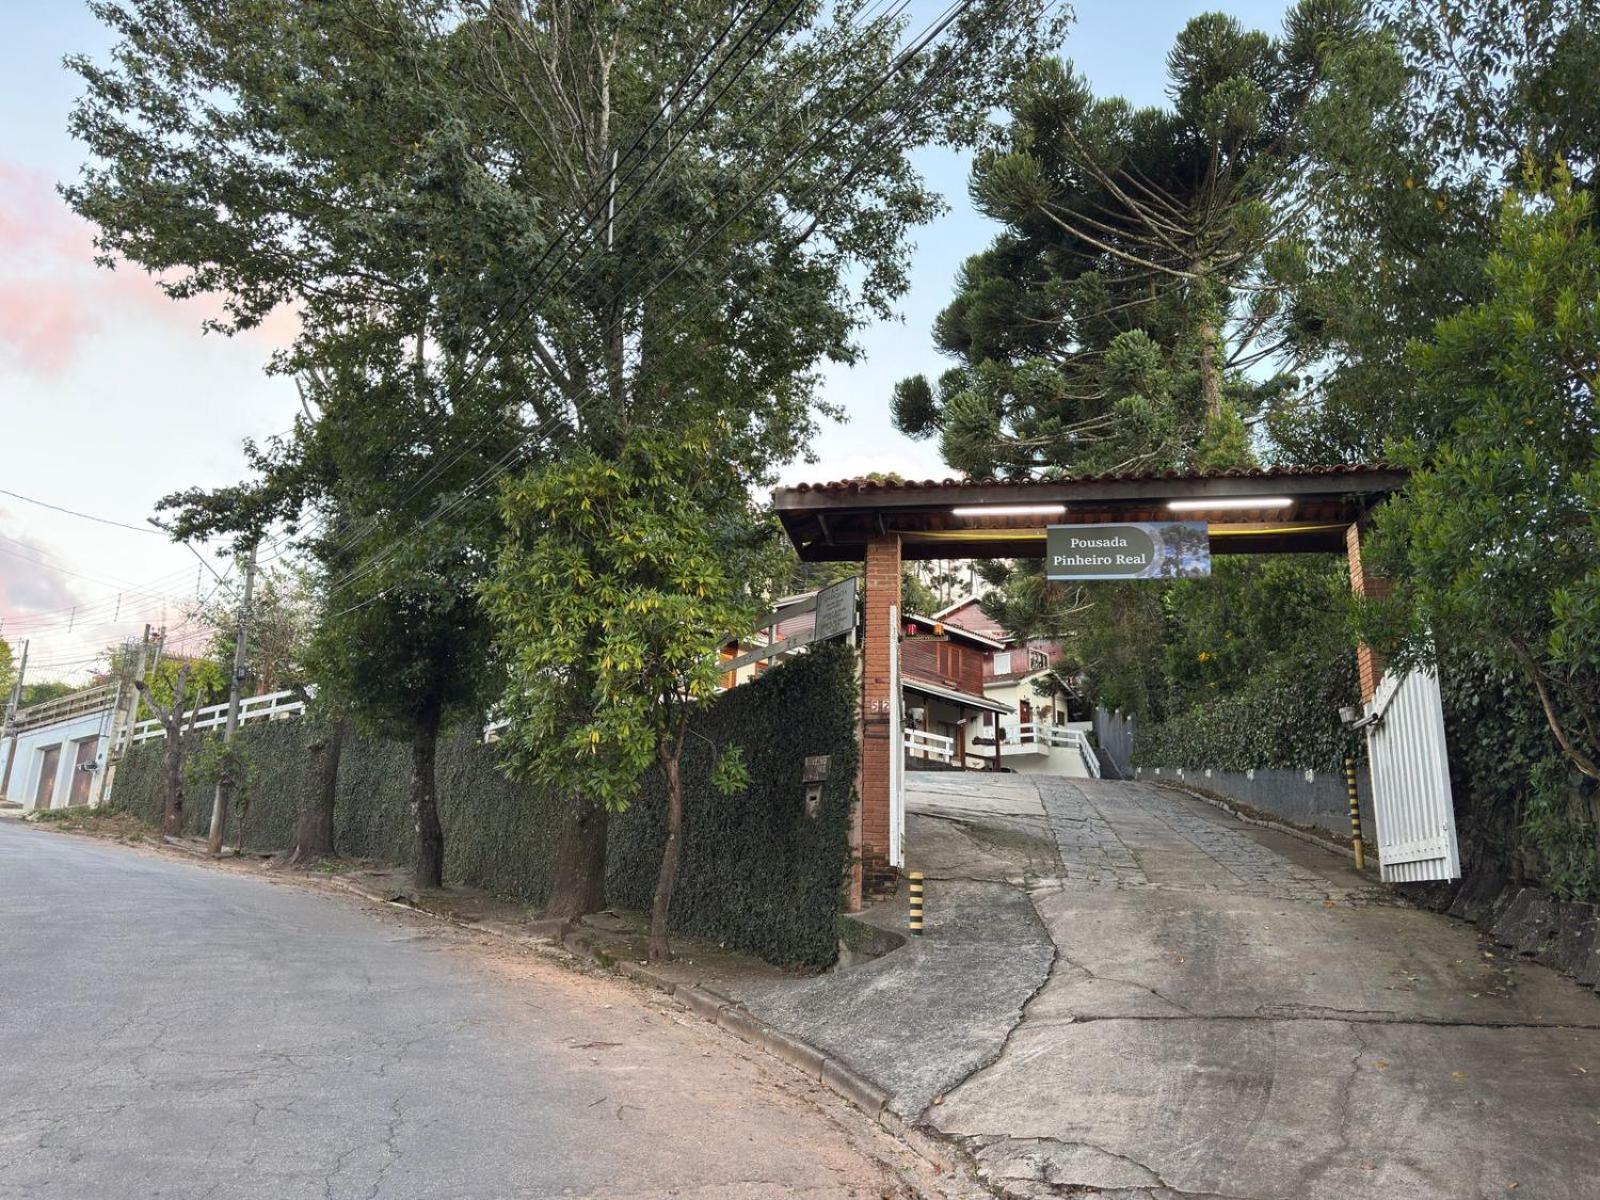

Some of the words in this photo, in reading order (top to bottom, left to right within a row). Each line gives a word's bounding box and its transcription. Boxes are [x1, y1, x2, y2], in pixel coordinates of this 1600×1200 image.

[1070, 536, 1128, 548] Pousada
[1053, 554, 1112, 565] Pinheiro
[1116, 553, 1146, 565] Real
